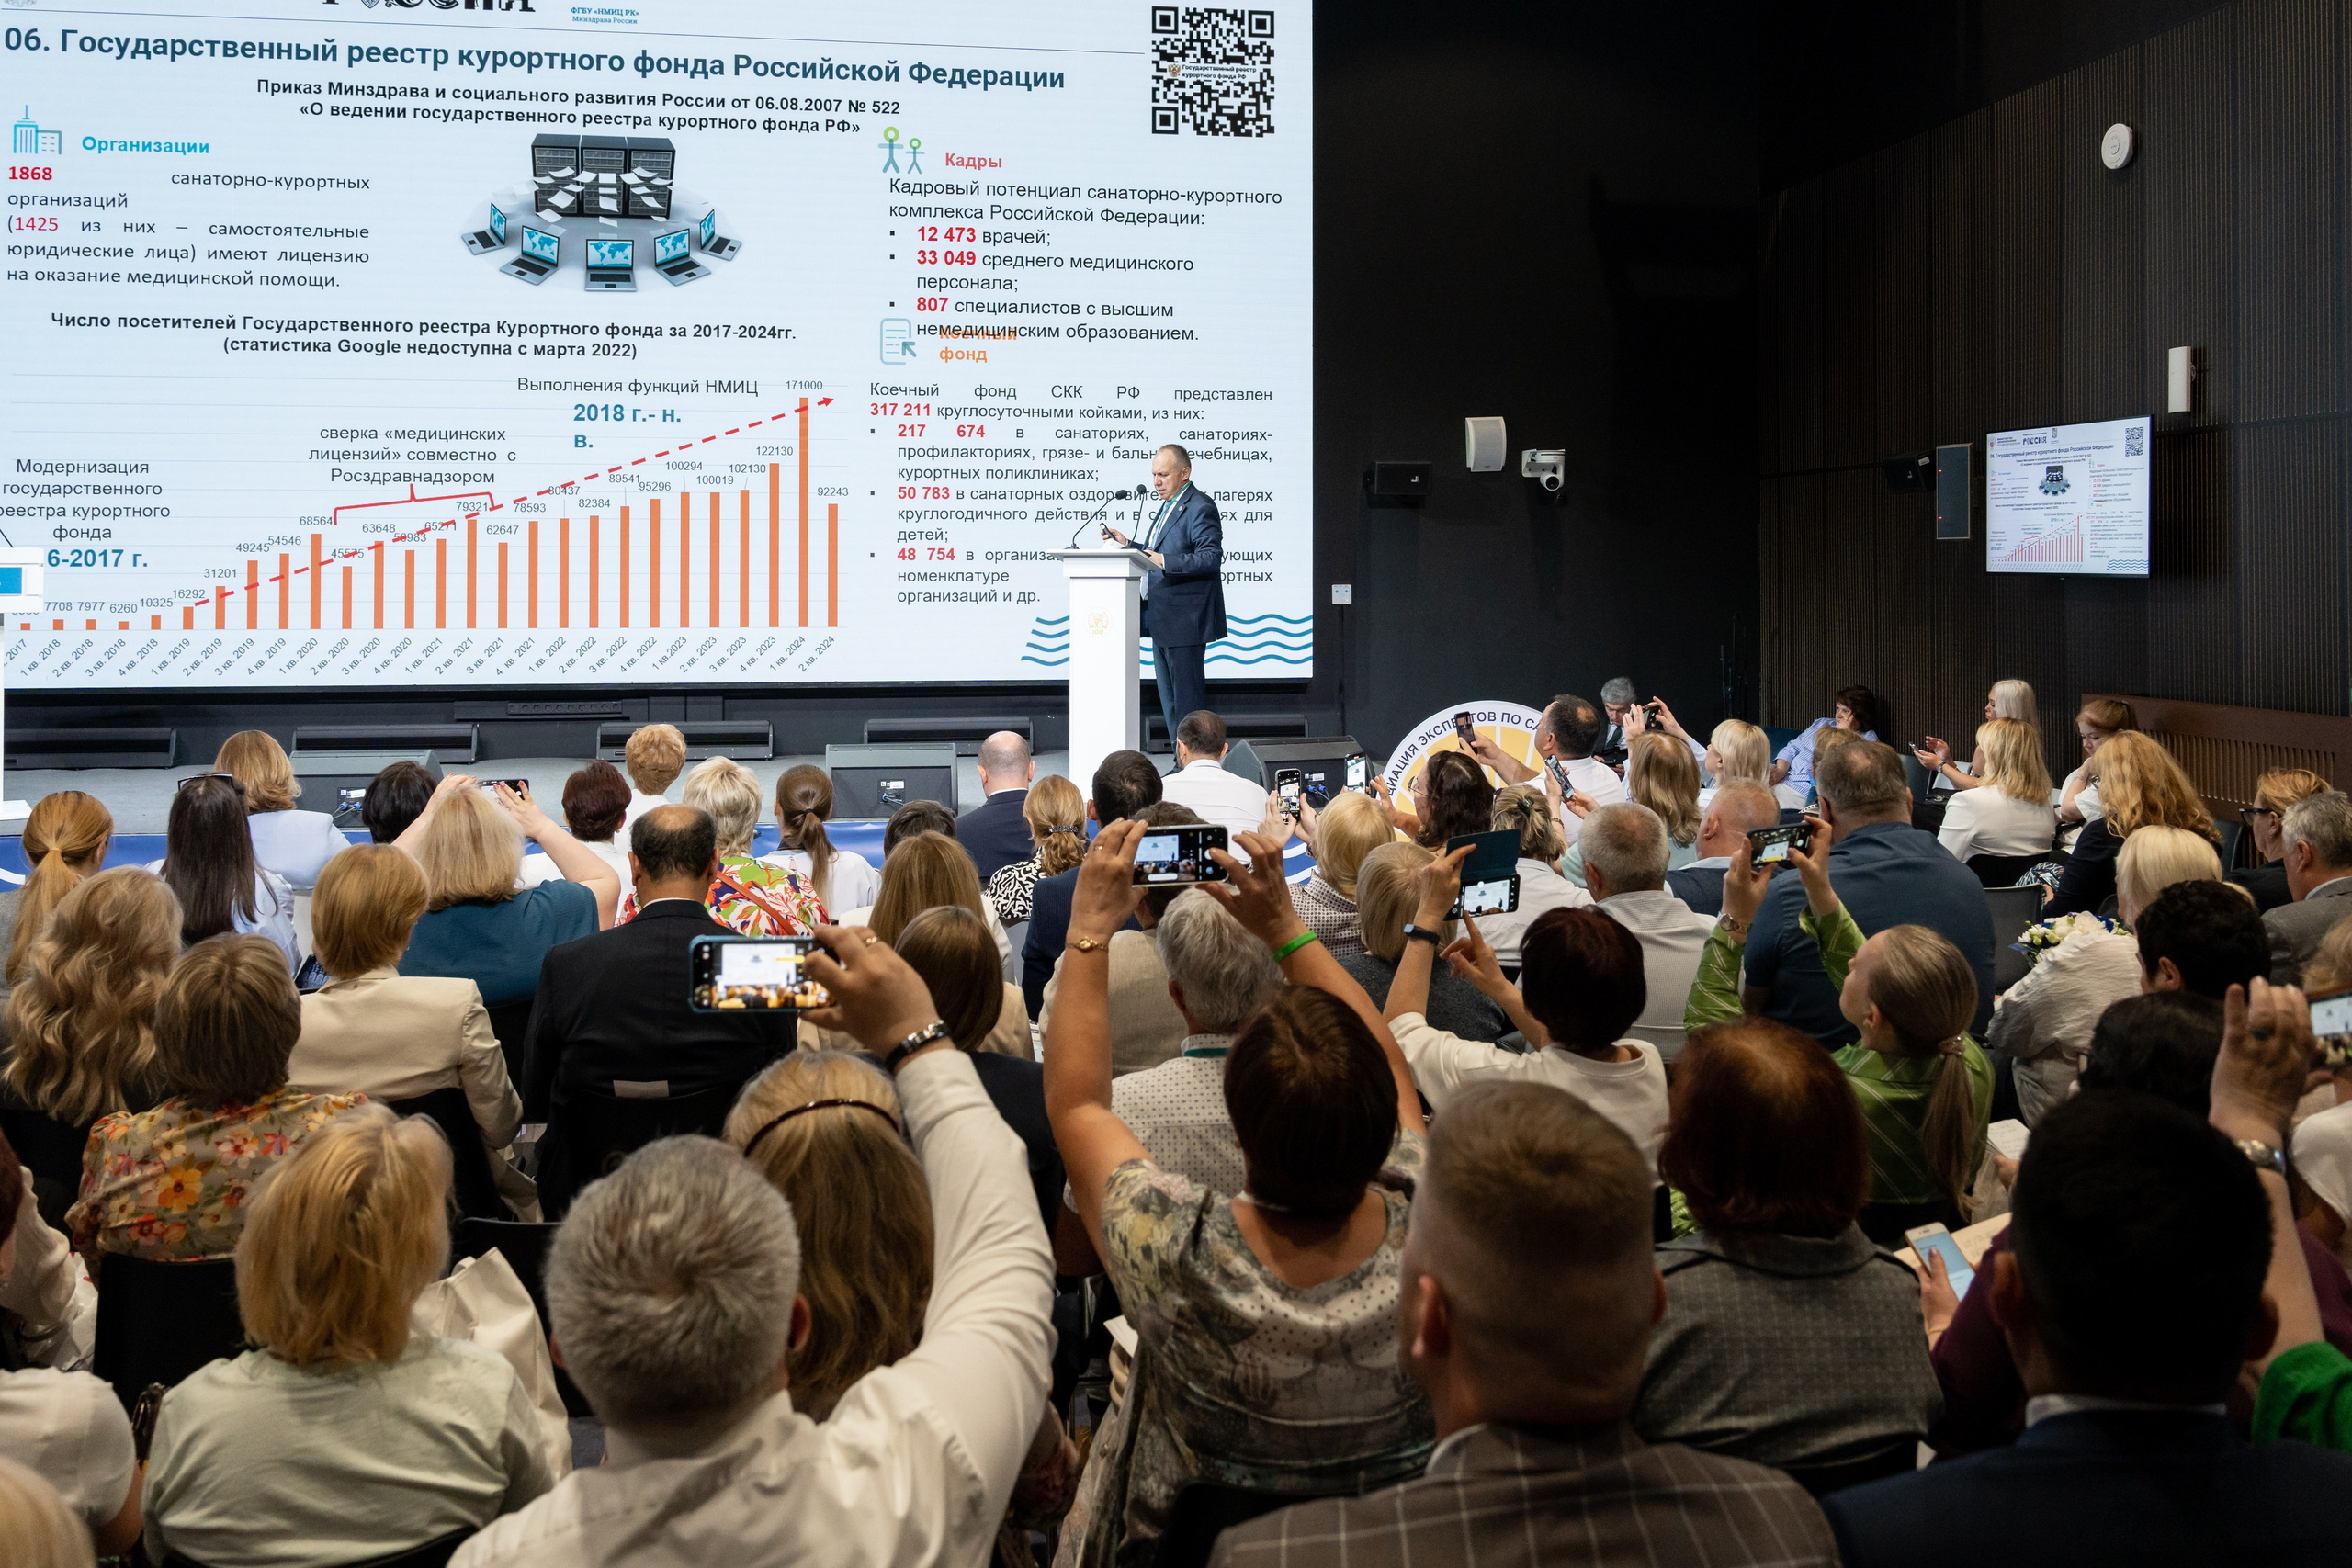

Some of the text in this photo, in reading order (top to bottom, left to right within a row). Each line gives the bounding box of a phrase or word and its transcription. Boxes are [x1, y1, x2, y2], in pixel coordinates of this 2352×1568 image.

[5, 27, 1065, 92] 06. Государственный реестр курортного фонда Российской Федерации
[257, 78, 900, 115] Приказ Минздрава социального развития России от 06.08.2007 № 522
[300, 101, 861, 134] «О ведении государственного реестра курортного фонда РФ»
[81, 135, 209, 156] Организации
[945, 152, 1002, 171] Кадры
[8, 165, 370, 192] 1868 санаторно-курортных
[7, 192, 128, 211] организаций
[889, 177, 1283, 207] Кадровый потенциал санаторно-курортного
[889, 204, 1204, 228] комплекса Российской Федерации:
[7, 214, 369, 239] (1425 из них самостоятельные
[917, 225, 1051, 247] 12 473 врачей;
[7, 243, 369, 265] юридические лица) имеют лицензию
[916, 249, 1194, 273] 33 049 среднего медицинского
[916, 296, 1173, 317] 807 специалистов высшим
[51, 312, 797, 340] Число посетителей Государственного реестра Курортного фонда за 2017-2024гг.
[917, 322, 1198, 343] немедицинским образованием.
[223, 336, 638, 361] (статистика Google недоступна марта 2022)
[939, 345, 988, 364] фонд
[517, 377, 759, 398] Выполнения функций НМИЦ
[786, 380, 823, 390] 171000
[870, 382, 1272, 403] Коечный фонд СКК РФ представлен
[573, 403, 625, 422] 2018
[869, 402, 1204, 422] 317 211 круглосуточными койками, из них:
[320, 428, 506, 444] сверка «медицинских
[897, 423, 1272, 443] 217 674 санаториях, санаториях-
[308, 446, 497, 464] лицензий» совместно
[755, 446, 794, 457] 122130
[898, 444, 1272, 462] профилакториях, грязе- бальнечебницах,
[17, 458, 149, 477] Модернизация
[665, 461, 704, 471] 100294
[729, 463, 767, 473] 102130
[898, 468, 1099, 482] курортных поликлиниках;
[332, 468, 494, 484] Росздравнадзором
[608, 474, 640, 483] 89541
[696, 475, 734, 485] 100019
[3, 483, 163, 499] государственного
[639, 481, 672, 491] 95296
[817, 487, 849, 497] 92243
[73, 506, 171, 521] курортного
[300, 516, 333, 526] 68564
[362, 523, 396, 533] 63648
[236, 542, 269, 553] 49245
[267, 535, 301, 546] 54546
[46, 548, 125, 568] 6-2017
[204, 568, 237, 579] 31201
[140, 597, 174, 608] 10325
[172, 589, 206, 599] 16292
[109, 603, 138, 614] 6260
[422, 637, 443, 658] 2021
[815, 636, 835, 655] 2024
[1418, 711, 1498, 746] ЭКСПЕТОВ
[1500, 712, 1521, 725] ПО
